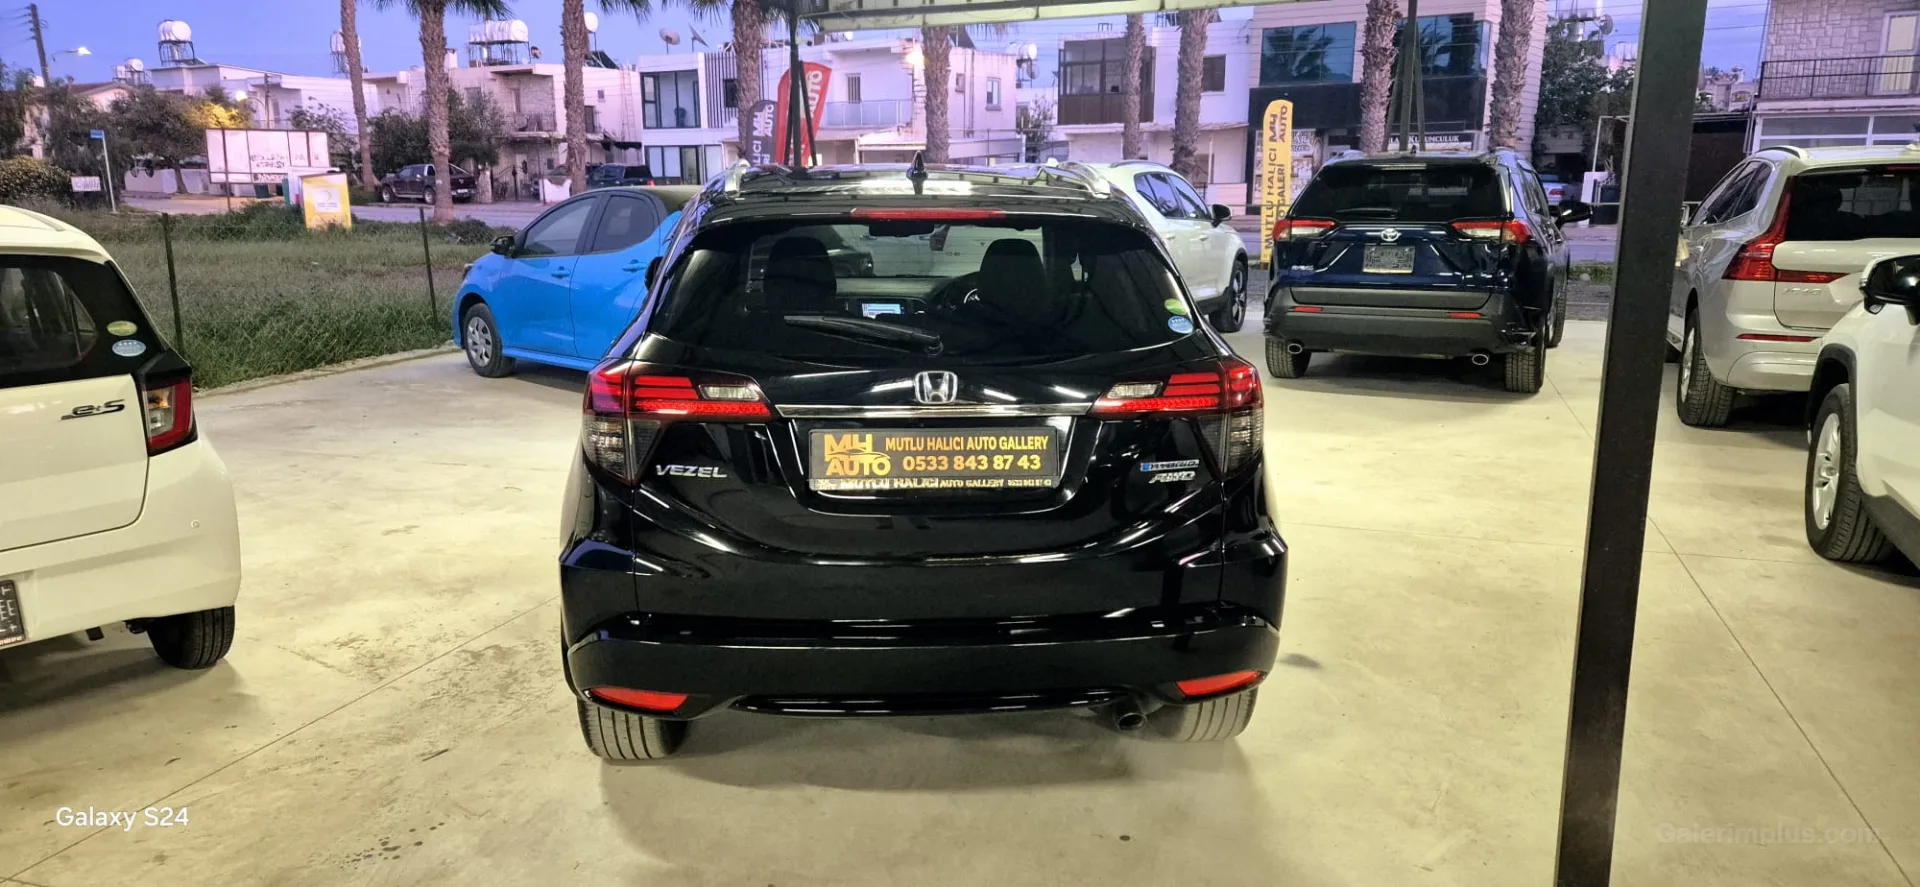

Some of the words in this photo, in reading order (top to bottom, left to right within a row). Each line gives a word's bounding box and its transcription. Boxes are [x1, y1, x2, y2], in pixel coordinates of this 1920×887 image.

[764, 104, 774, 137] AUTO
[1279, 105, 1288, 143] AUTO
[1264, 200, 1275, 250] MUTLU
[824, 433, 873, 460] MH
[886, 437, 926, 451] MUTLU
[929, 436, 964, 451] HALICI
[966, 436, 997, 450] AUTO
[999, 436, 1049, 450] GALLERY
[656, 464, 728, 478] VEZEL
[825, 457, 892, 476] AUTO
[902, 455, 949, 471] 0533
[953, 455, 989, 470] 843
[993, 455, 1014, 470] 87
[1017, 454, 1041, 470] 43
[940, 480, 964, 488] AUTO
